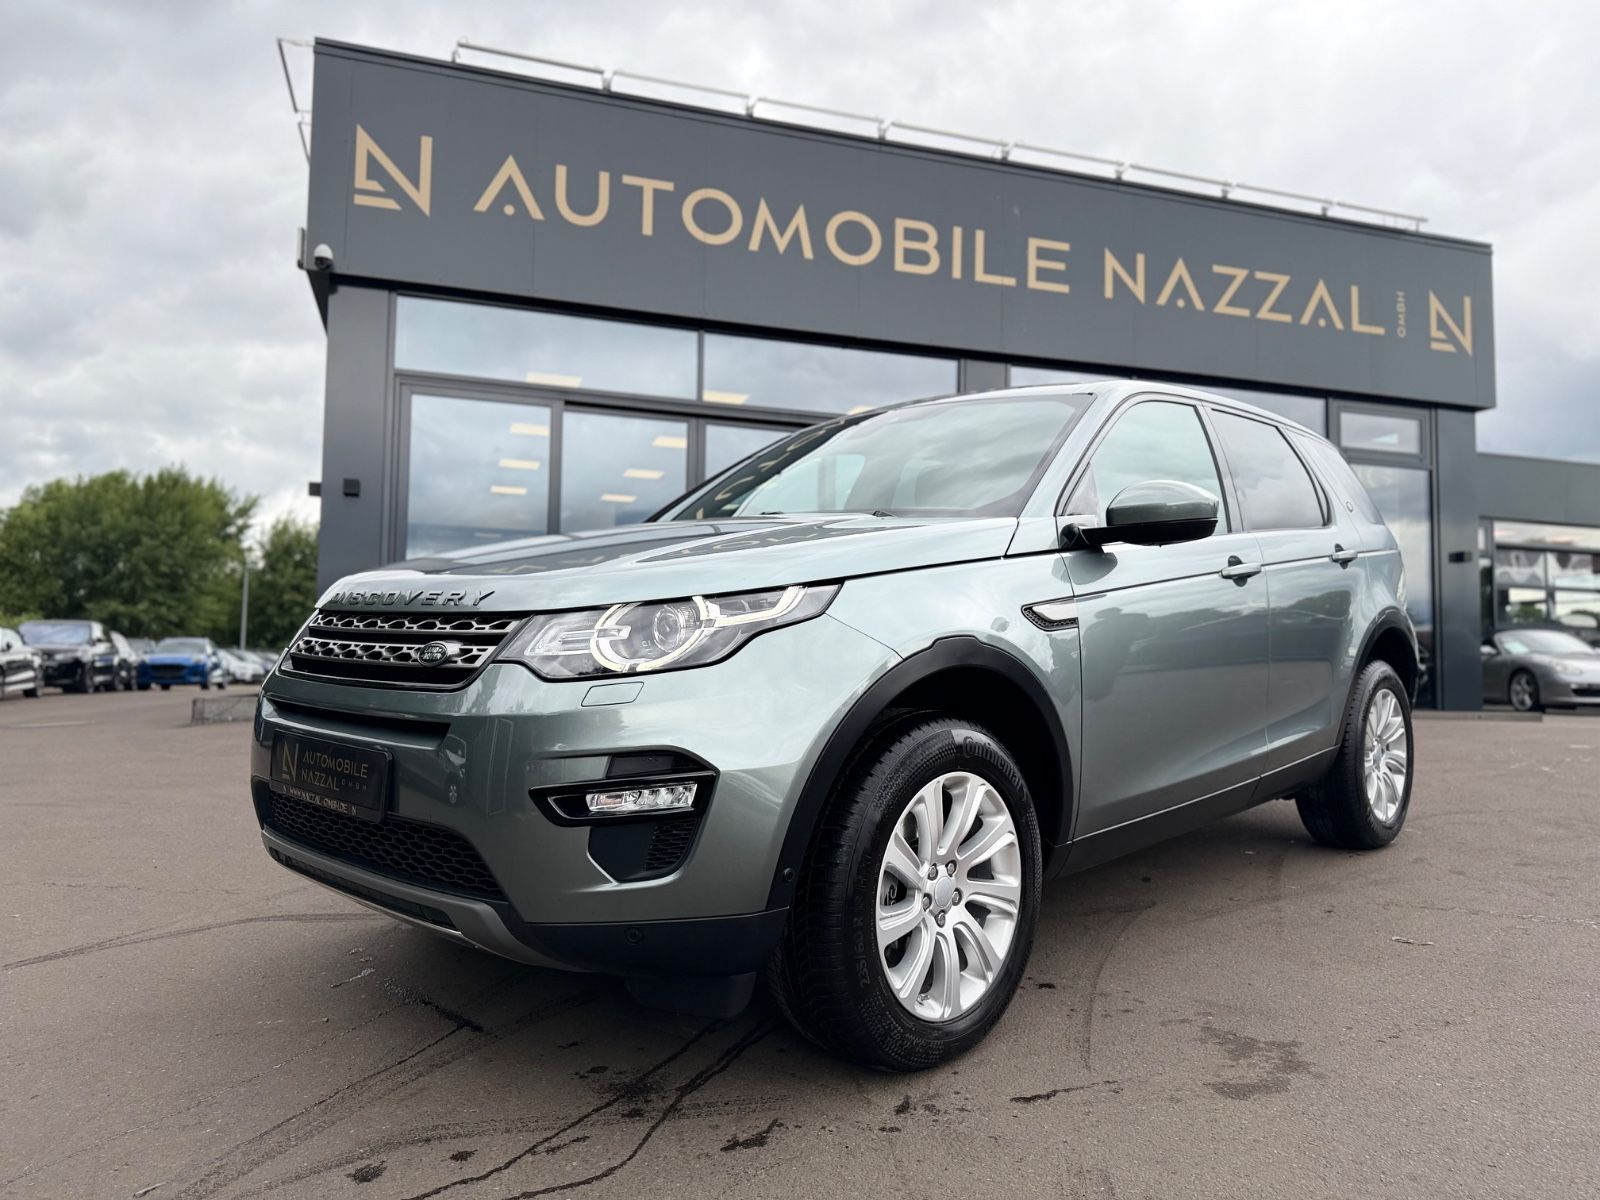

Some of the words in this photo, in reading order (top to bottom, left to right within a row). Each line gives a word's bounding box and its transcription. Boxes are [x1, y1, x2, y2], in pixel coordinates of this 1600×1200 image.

[473, 154, 1070, 293] AUTOMOBILE
[1104, 247, 1385, 335] NAZZAL
[330, 590, 495, 607] DISCOVERY
[303, 749, 369, 779] AUTOMOBILE
[301, 768, 340, 791] NAZZAL
